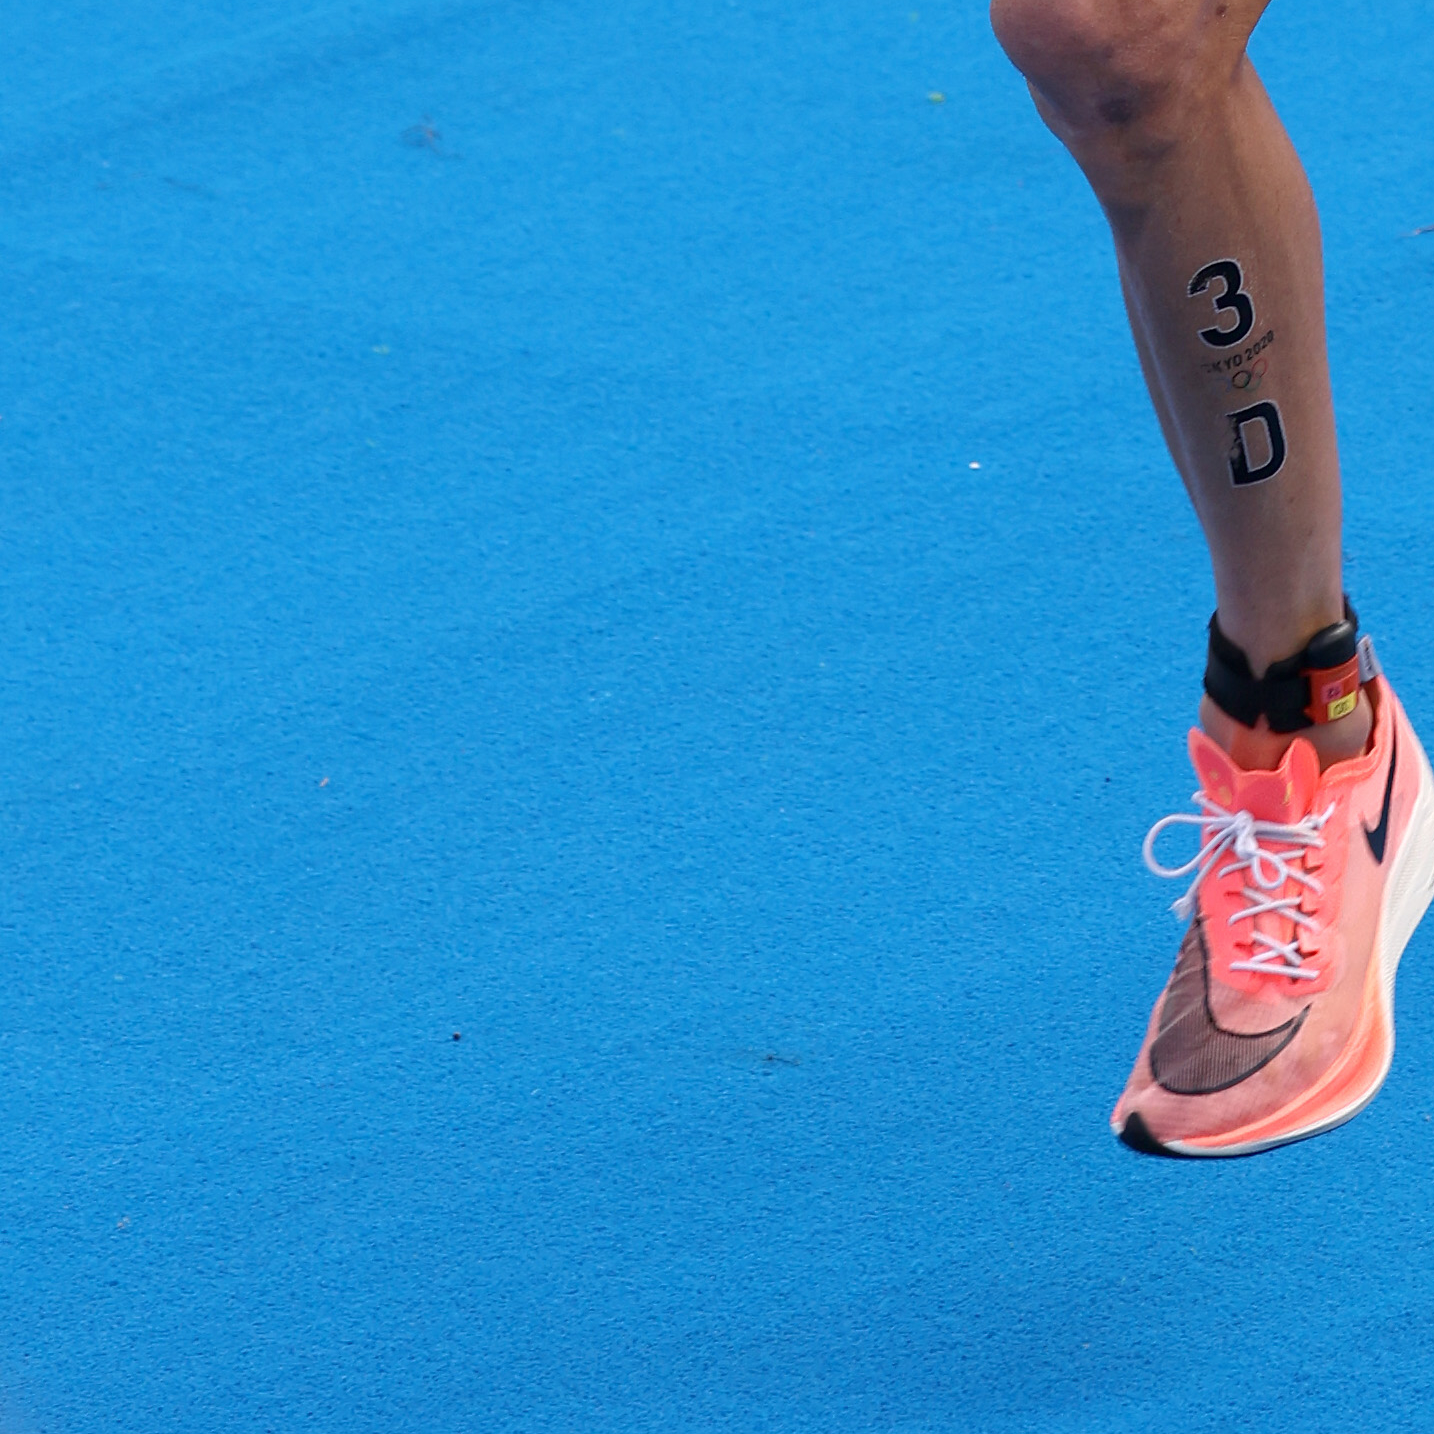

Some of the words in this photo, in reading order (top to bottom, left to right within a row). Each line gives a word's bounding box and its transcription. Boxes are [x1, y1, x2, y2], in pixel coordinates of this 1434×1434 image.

[1186, 258, 1256, 349] 3
[1201, 353, 1243, 374] KYO
[1244, 330, 1275, 362] 2020
[1225, 399, 1288, 488] D
